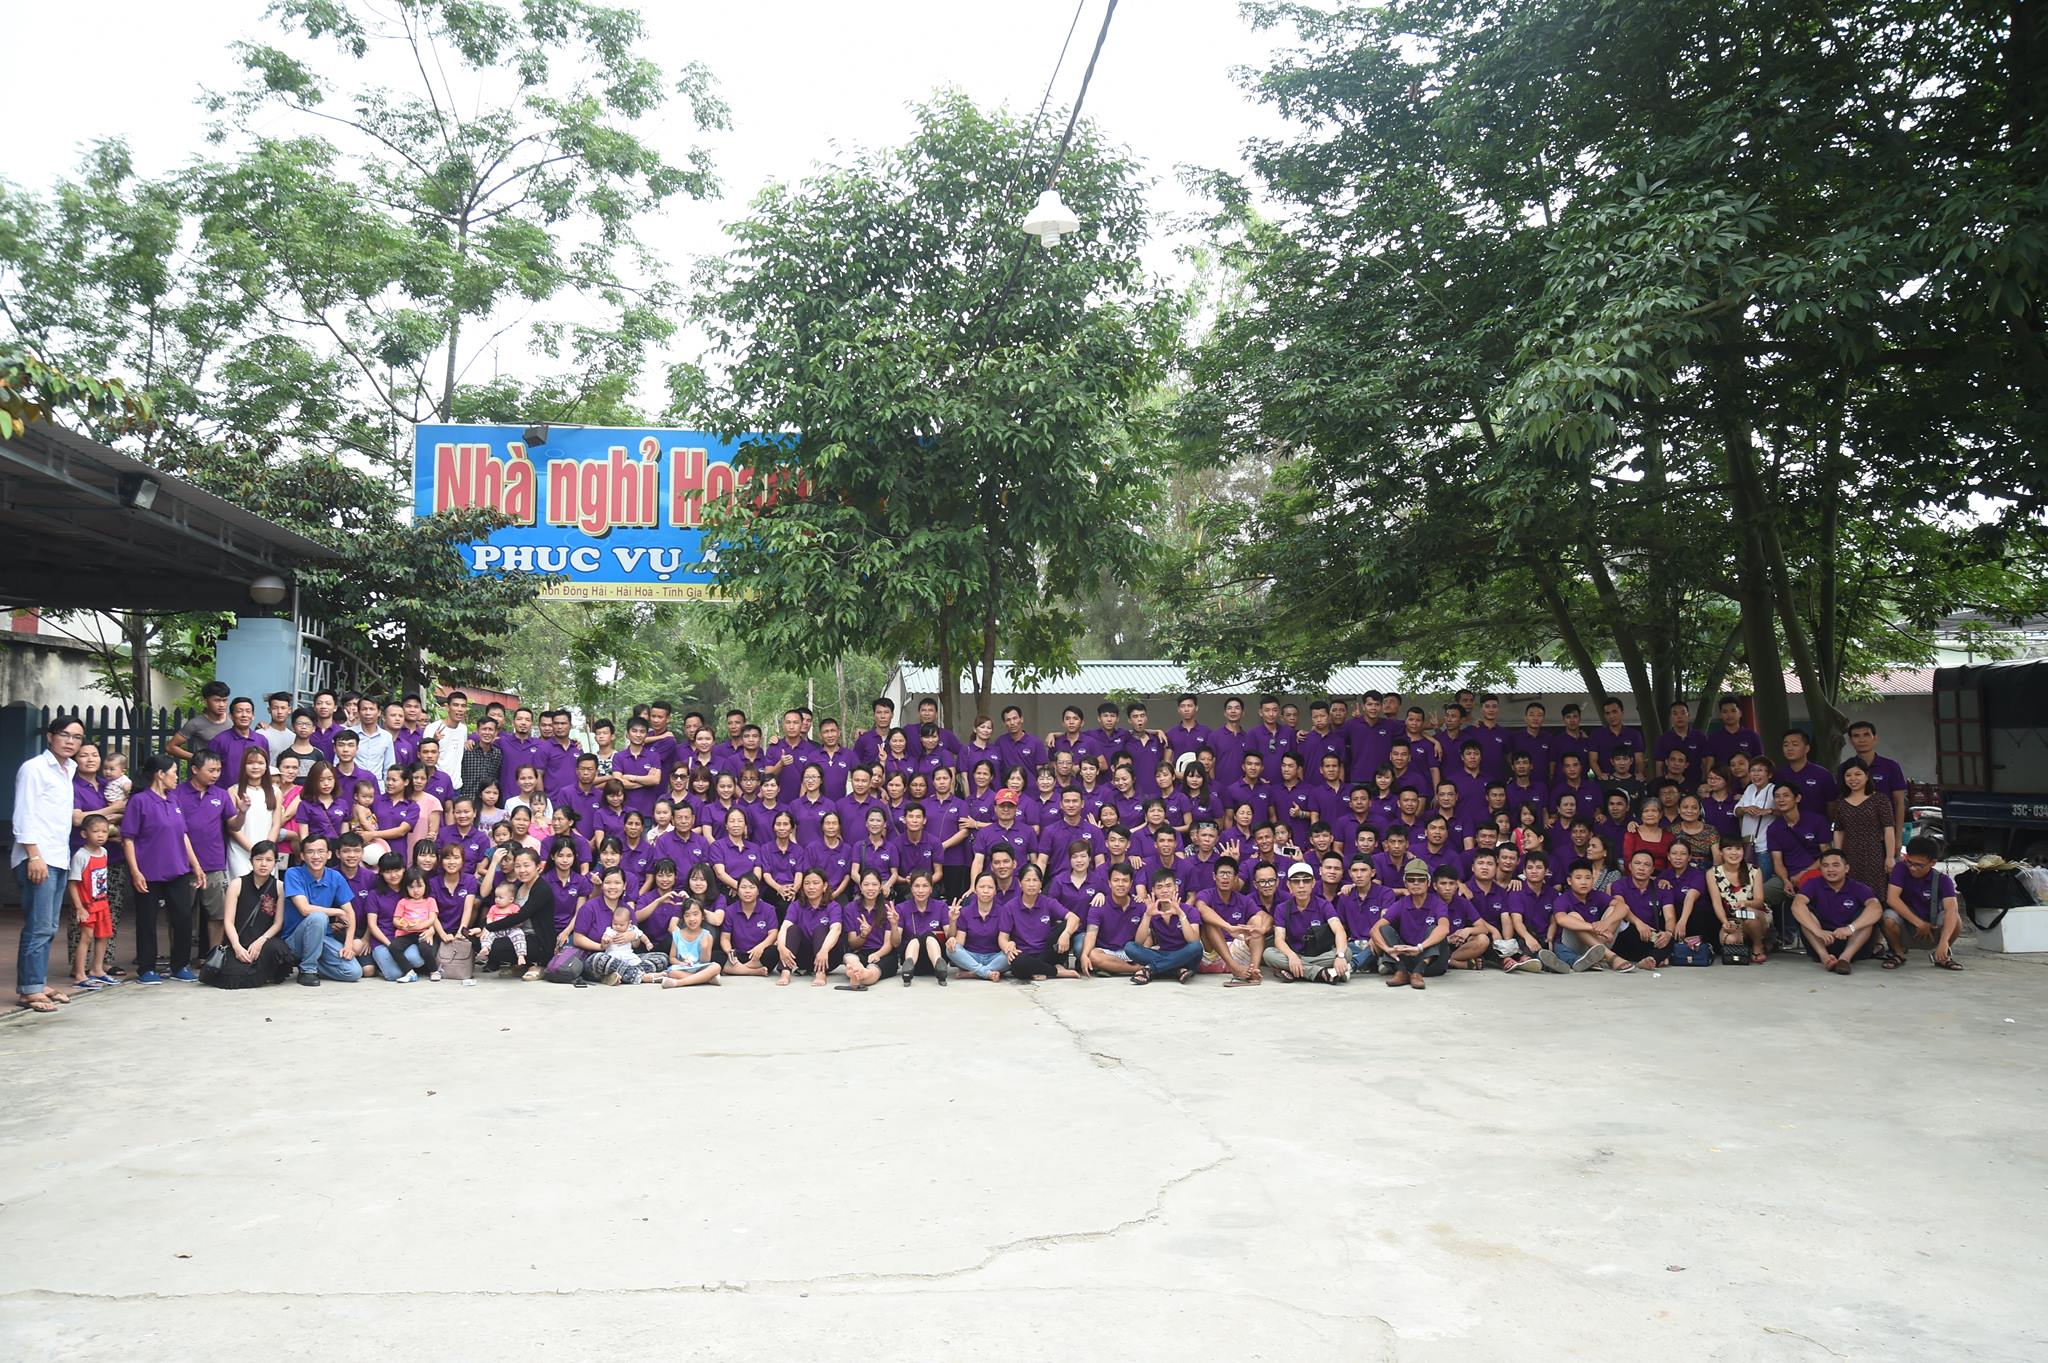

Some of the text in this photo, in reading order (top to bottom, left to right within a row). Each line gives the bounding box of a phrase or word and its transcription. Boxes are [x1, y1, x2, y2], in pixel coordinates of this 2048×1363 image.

[434, 441, 536, 525] Nhà
[547, 436, 661, 537] nghỉ
[612, 547, 683, 581] VỤ
